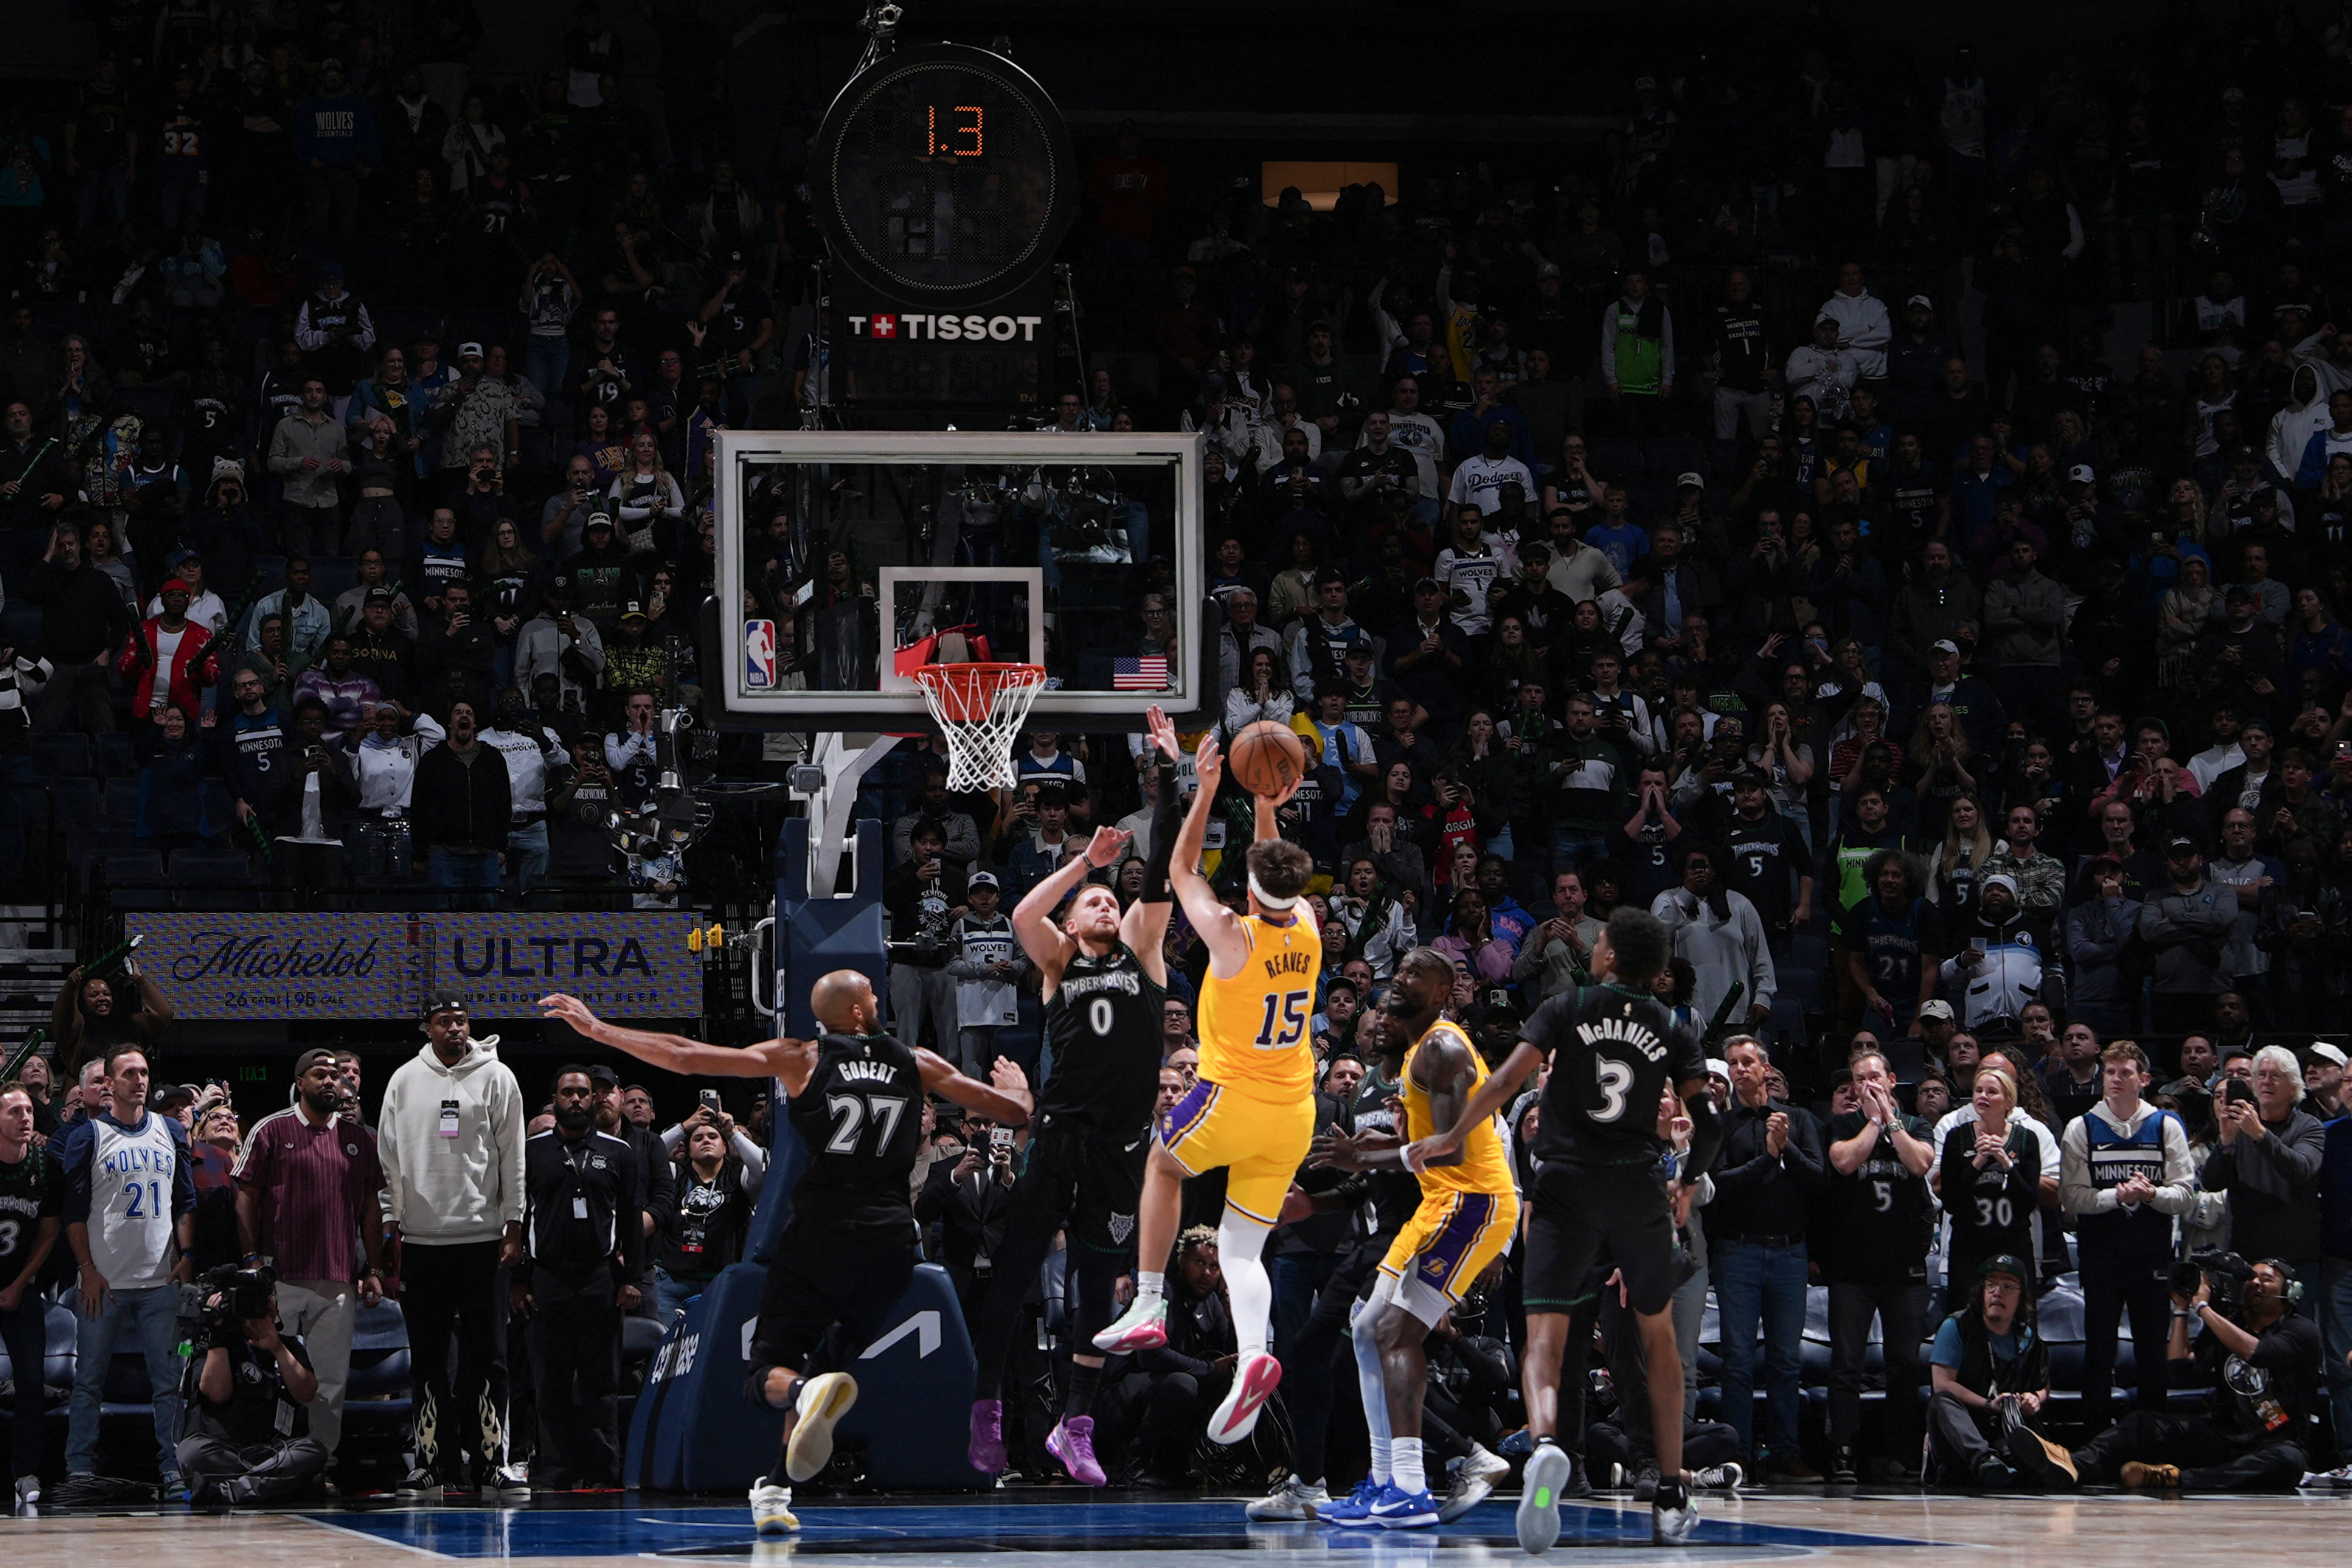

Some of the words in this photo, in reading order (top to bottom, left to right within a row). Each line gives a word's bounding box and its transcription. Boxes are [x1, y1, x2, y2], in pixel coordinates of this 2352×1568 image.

[316, 111, 353, 130] WOLVES
[929, 105, 983, 156] 1.3
[164, 131, 199, 156] 32
[483, 213, 505, 233] 21
[733, 316, 743, 330] 5
[901, 314, 1041, 341] TISSOT
[1726, 320, 1760, 330] MINNESOTA
[1461, 330, 1472, 350] 2
[1728, 330, 1761, 339] BASKETBALL
[1636, 338, 1641, 355] 1
[1743, 338, 1750, 355] 1
[598, 382, 618, 403] 19
[204, 411, 216, 428] 5
[1468, 471, 1522, 487] Dodgers
[1911, 510, 1923, 528] 5
[1459, 569, 1493, 577] WOLVES
[1474, 577, 1482, 592] 1
[749, 672, 764, 683] NBA
[238, 738, 282, 754] MINNESOTA
[257, 752, 271, 771] 5
[635, 768, 648, 787] 5
[1295, 802, 1311, 822] 11
[1651, 845, 1665, 866] 5
[1730, 841, 1780, 861] TIMBERWOLVES
[656, 863, 673, 879] 27
[1749, 856, 1764, 877] 5
[920, 889, 948, 901] SENIOR
[1957, 883, 1970, 905] 5
[969, 943, 1007, 952] WOLVES
[1867, 934, 1918, 954] TIMBERWOLVES
[173, 932, 381, 982] Michelob
[454, 937, 654, 977] ULTRA
[1265, 952, 1311, 979] REAVES
[1878, 956, 1907, 980] 21
[615, 993, 659, 1003] BEER
[1059, 968, 1141, 1010] TIMBERWOLVES
[1089, 996, 1114, 1036] 0
[1252, 990, 1310, 1051] 15
[1575, 1016, 1668, 1064] McDANIELS
[837, 1061, 898, 1084] GOBERT
[1586, 1050, 1634, 1123] 3
[825, 1092, 909, 1156] 27
[104, 1146, 176, 1182] WOLVES
[2094, 1164, 2162, 1182] MINNESOTA
[123, 1180, 161, 1218] 21
[1873, 1180, 1893, 1213] 5
[1974, 1196, 2013, 1228] 30
[0, 1218, 21, 1257] 3
[187, 1293, 193, 1306] 2
